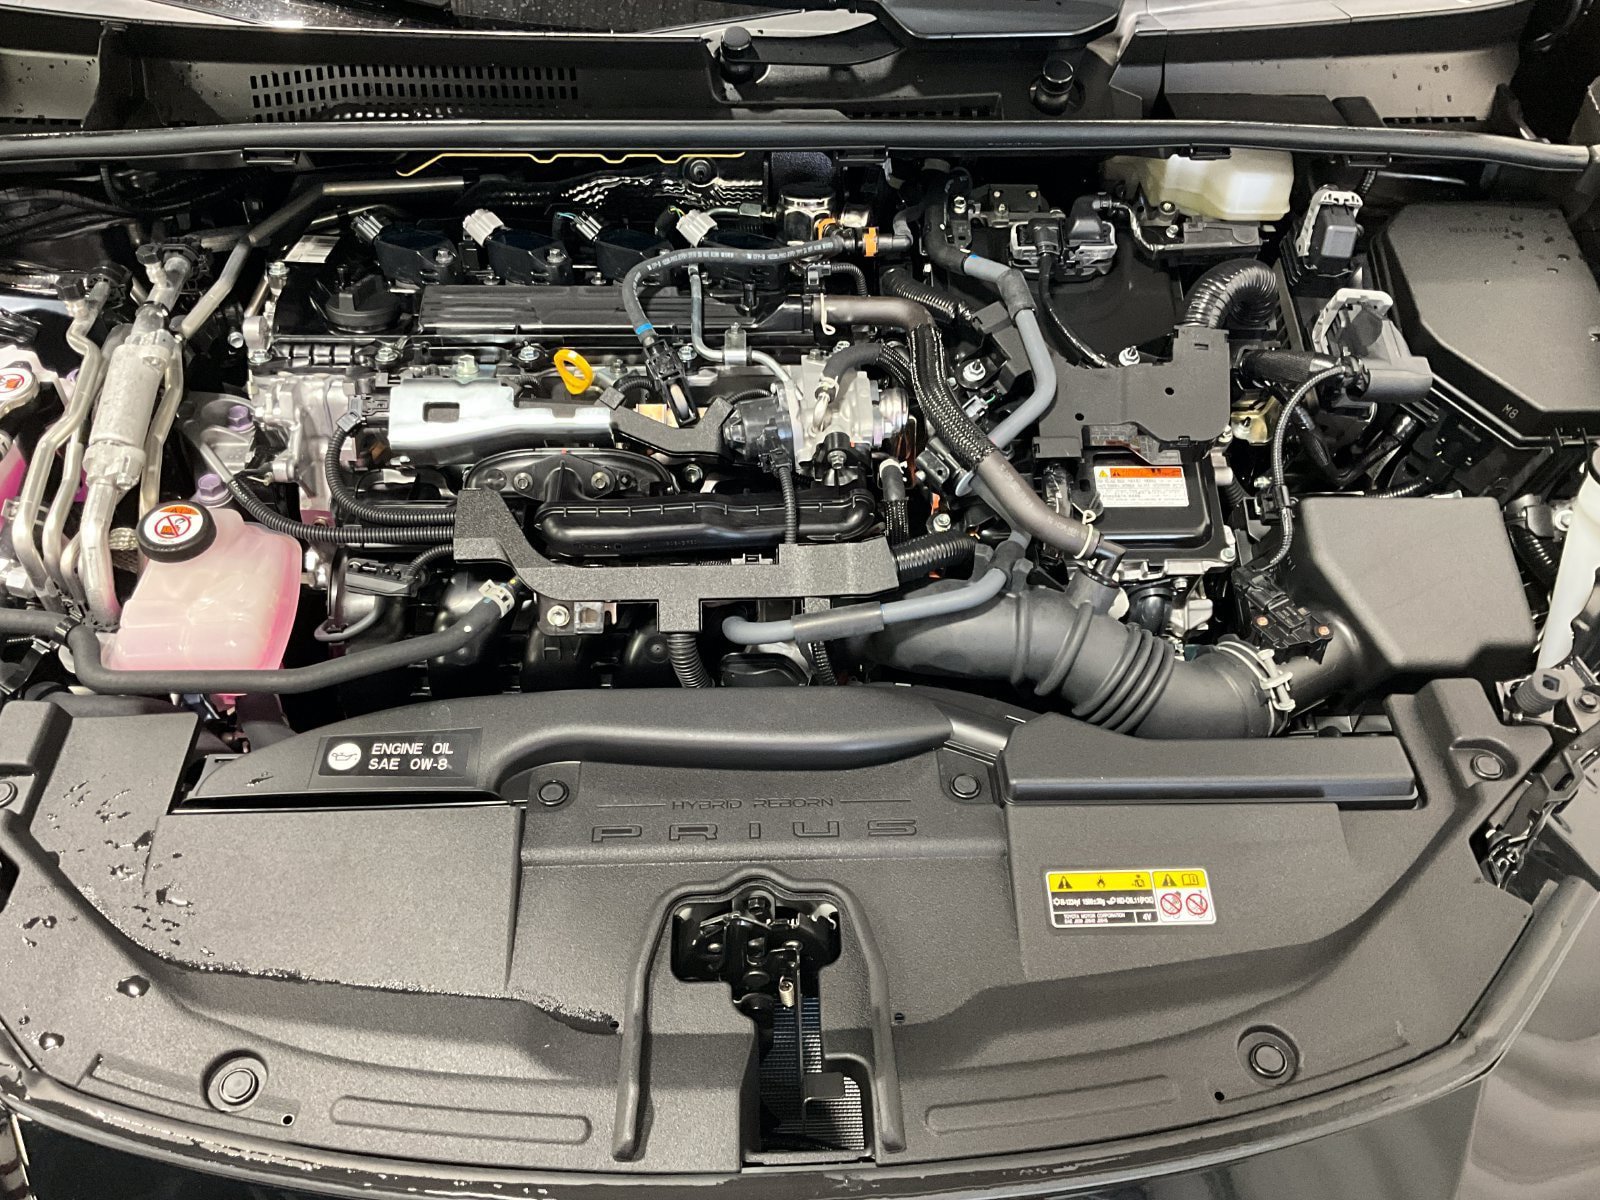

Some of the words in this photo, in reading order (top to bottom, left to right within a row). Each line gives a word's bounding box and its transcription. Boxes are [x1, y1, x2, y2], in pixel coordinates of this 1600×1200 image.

[371, 743, 423, 755] ENGINE
[432, 742, 454, 755] OIL
[368, 758, 400, 770] SAE
[672, 799, 743, 810] HYBRID
[753, 798, 834, 808] REBORN
[591, 819, 917, 843] PRIUS
